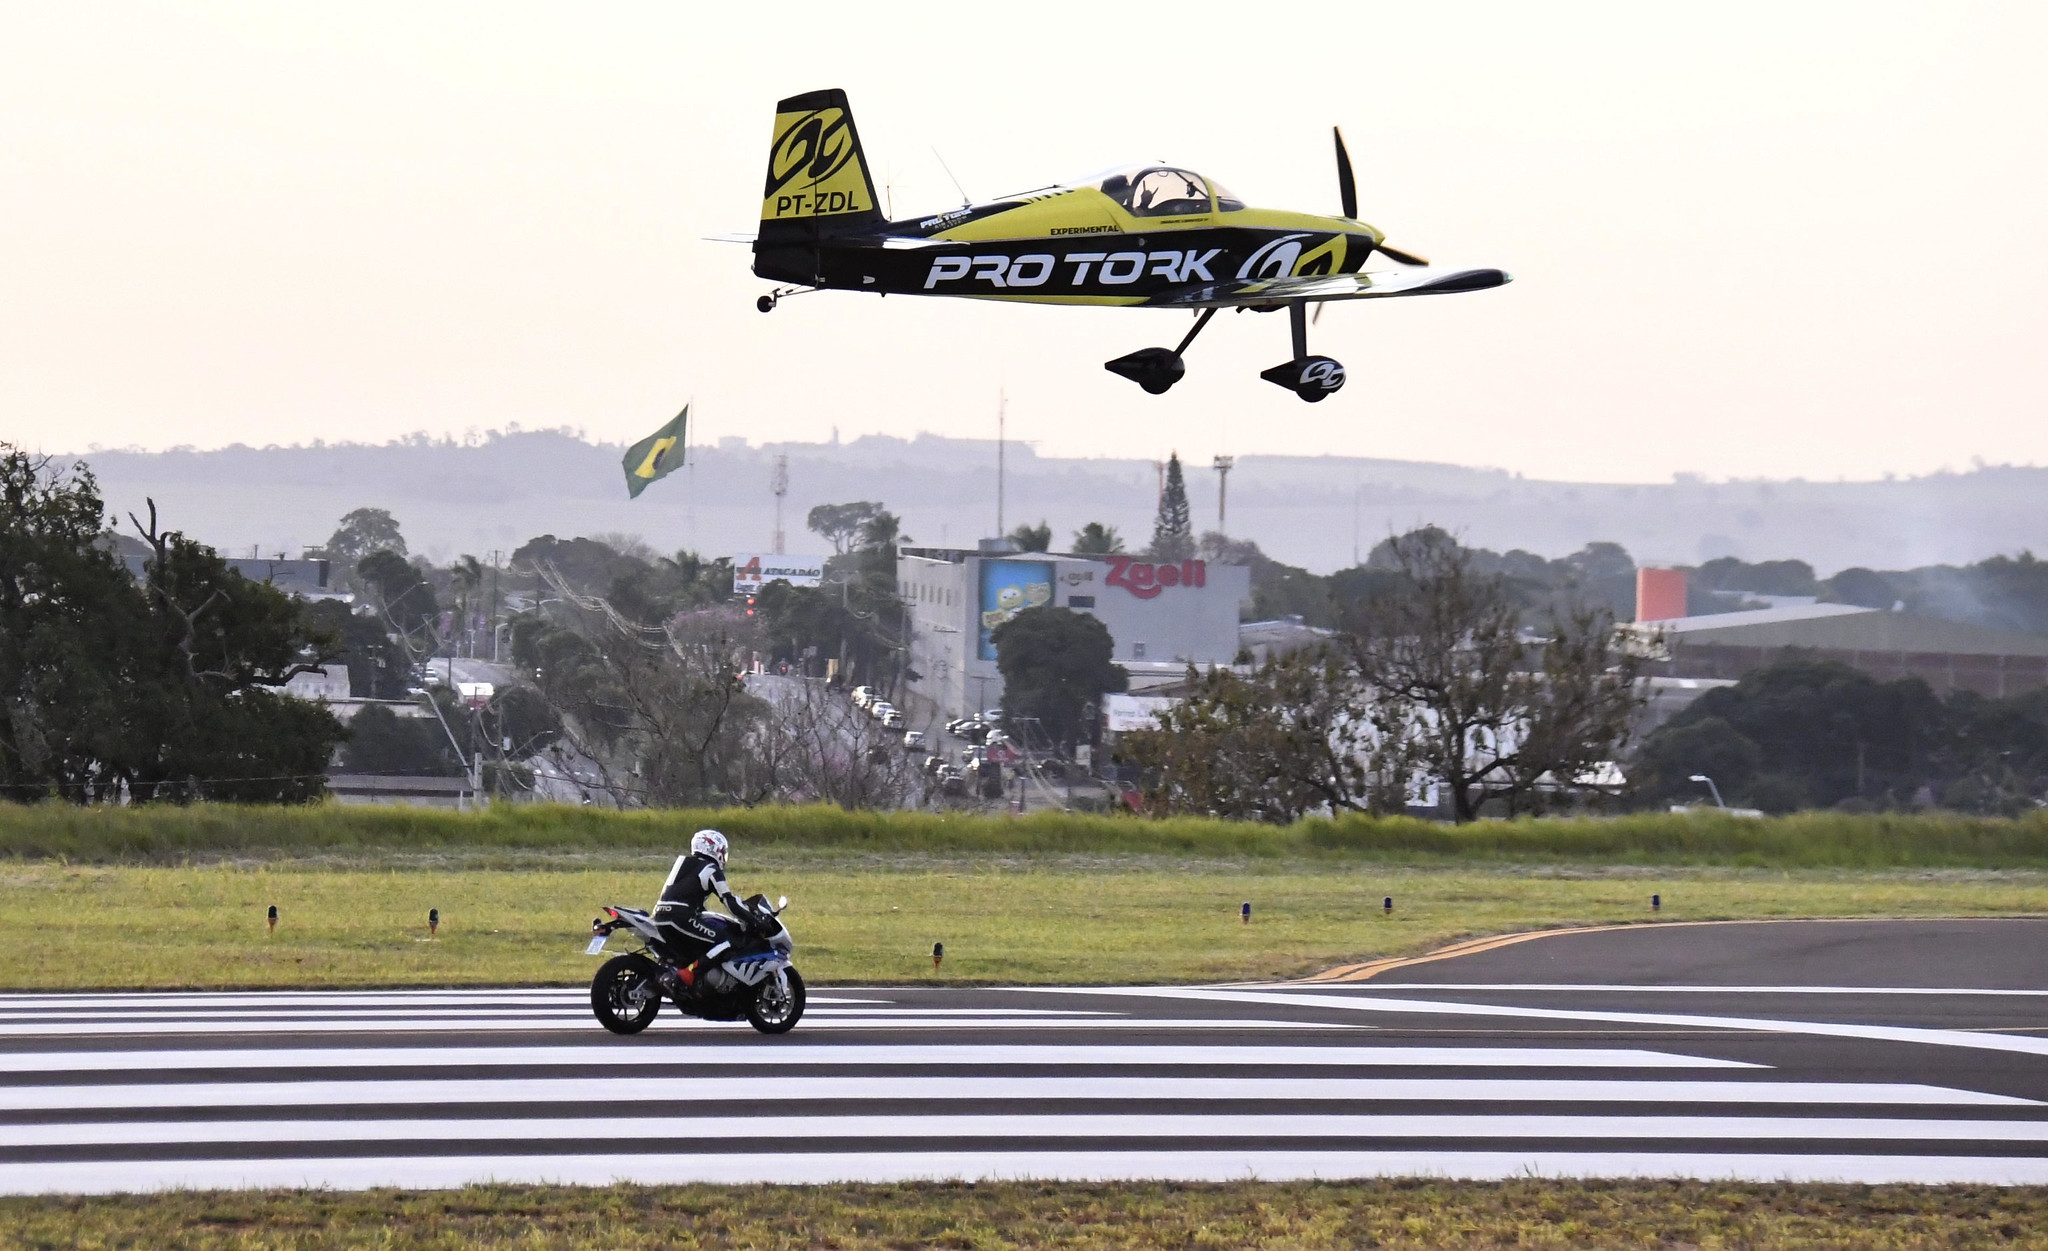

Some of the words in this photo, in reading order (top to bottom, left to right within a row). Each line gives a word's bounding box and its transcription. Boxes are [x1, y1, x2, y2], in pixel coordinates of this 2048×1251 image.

[776, 190, 859, 217] PT-ZDL
[1050, 225, 1119, 236] EXPERIMENTAL
[923, 254, 1056, 289] PRO
[1064, 249, 1222, 286] TORK
